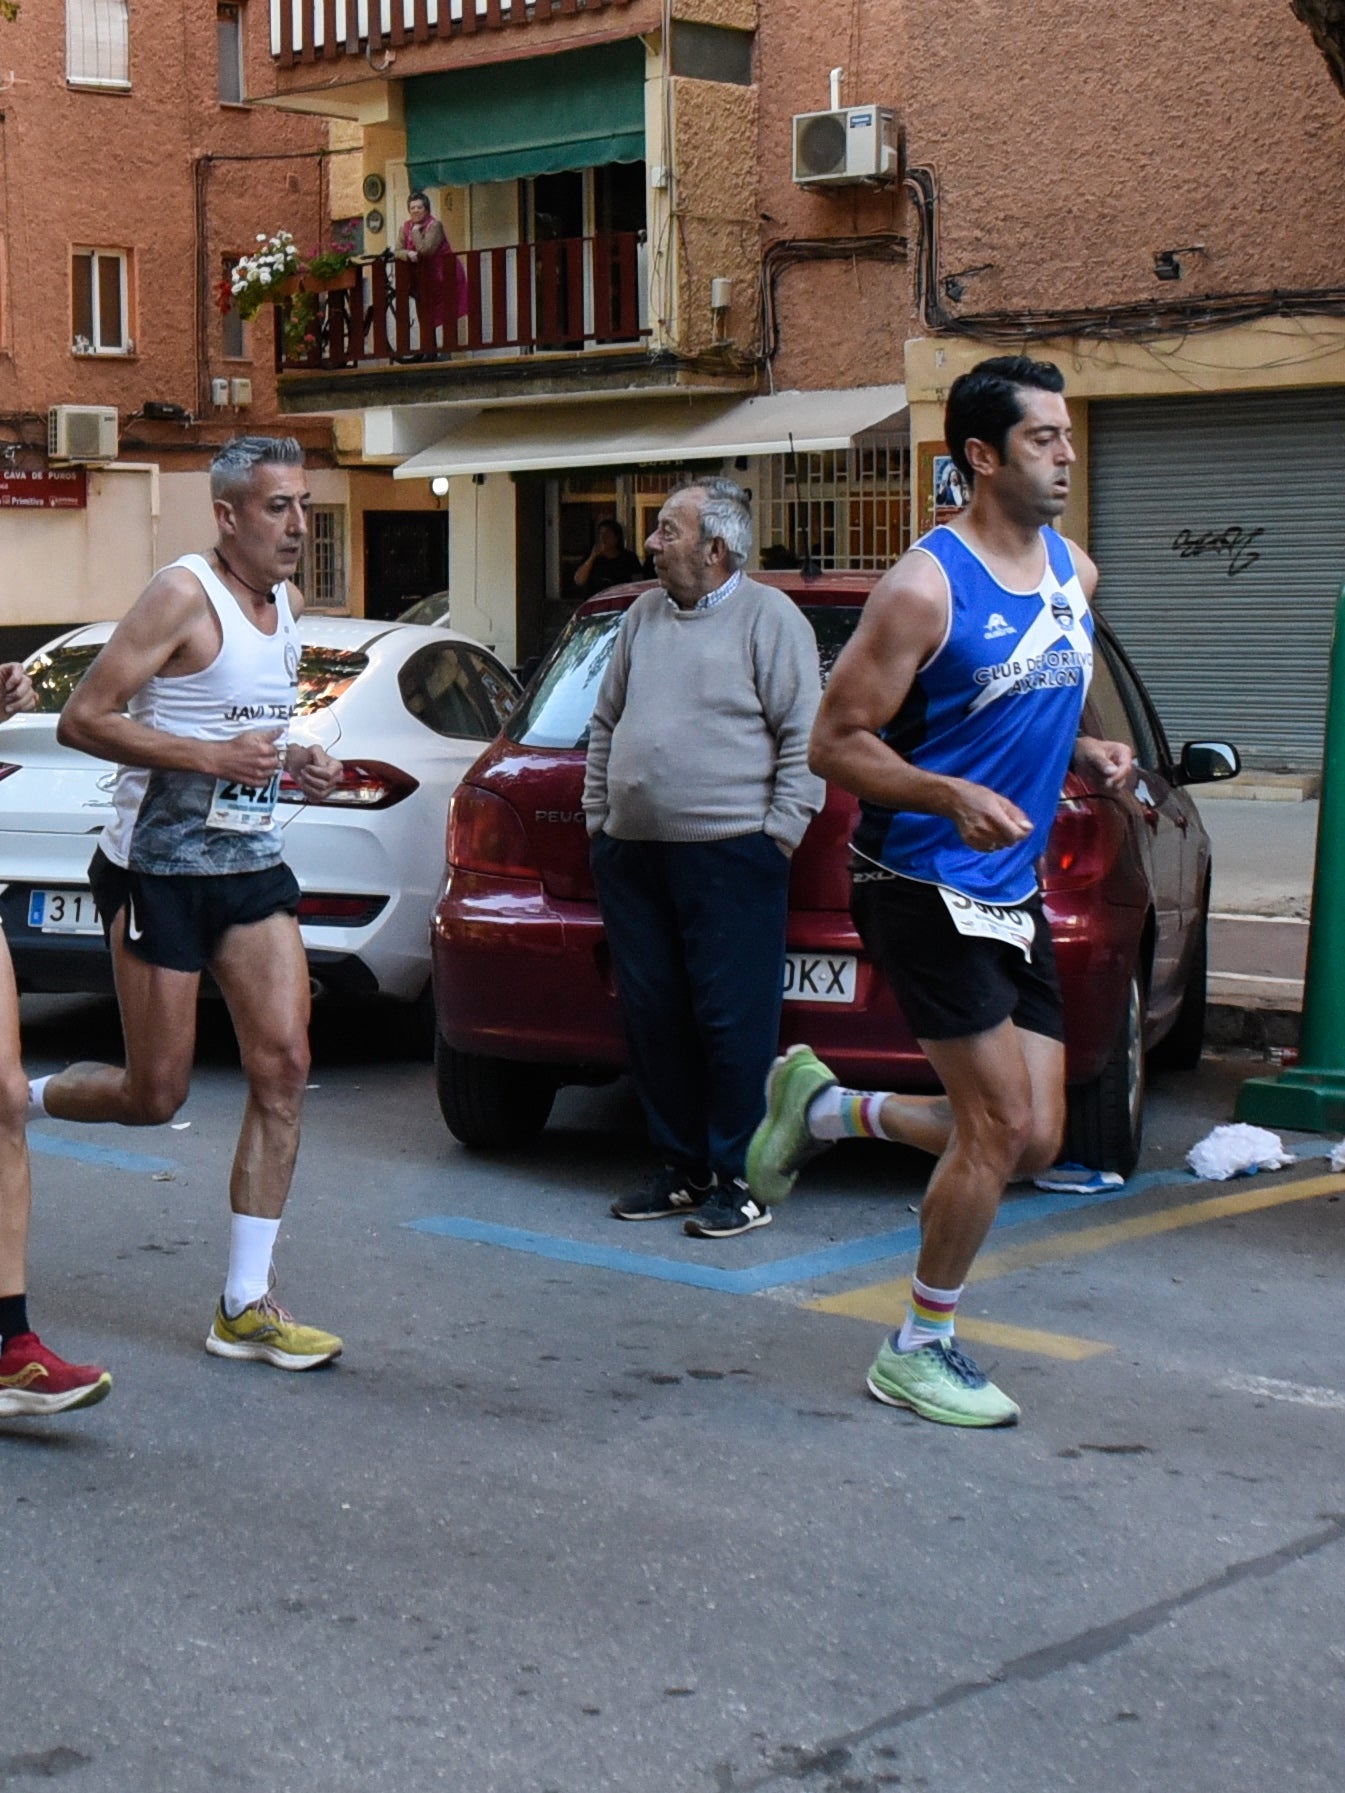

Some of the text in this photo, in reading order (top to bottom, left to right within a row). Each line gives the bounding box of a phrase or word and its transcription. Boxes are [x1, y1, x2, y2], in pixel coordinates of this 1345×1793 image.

[3, 470, 27, 479] CAVA
[31, 470, 43, 479] DE
[974, 661, 1023, 685] CLUB
